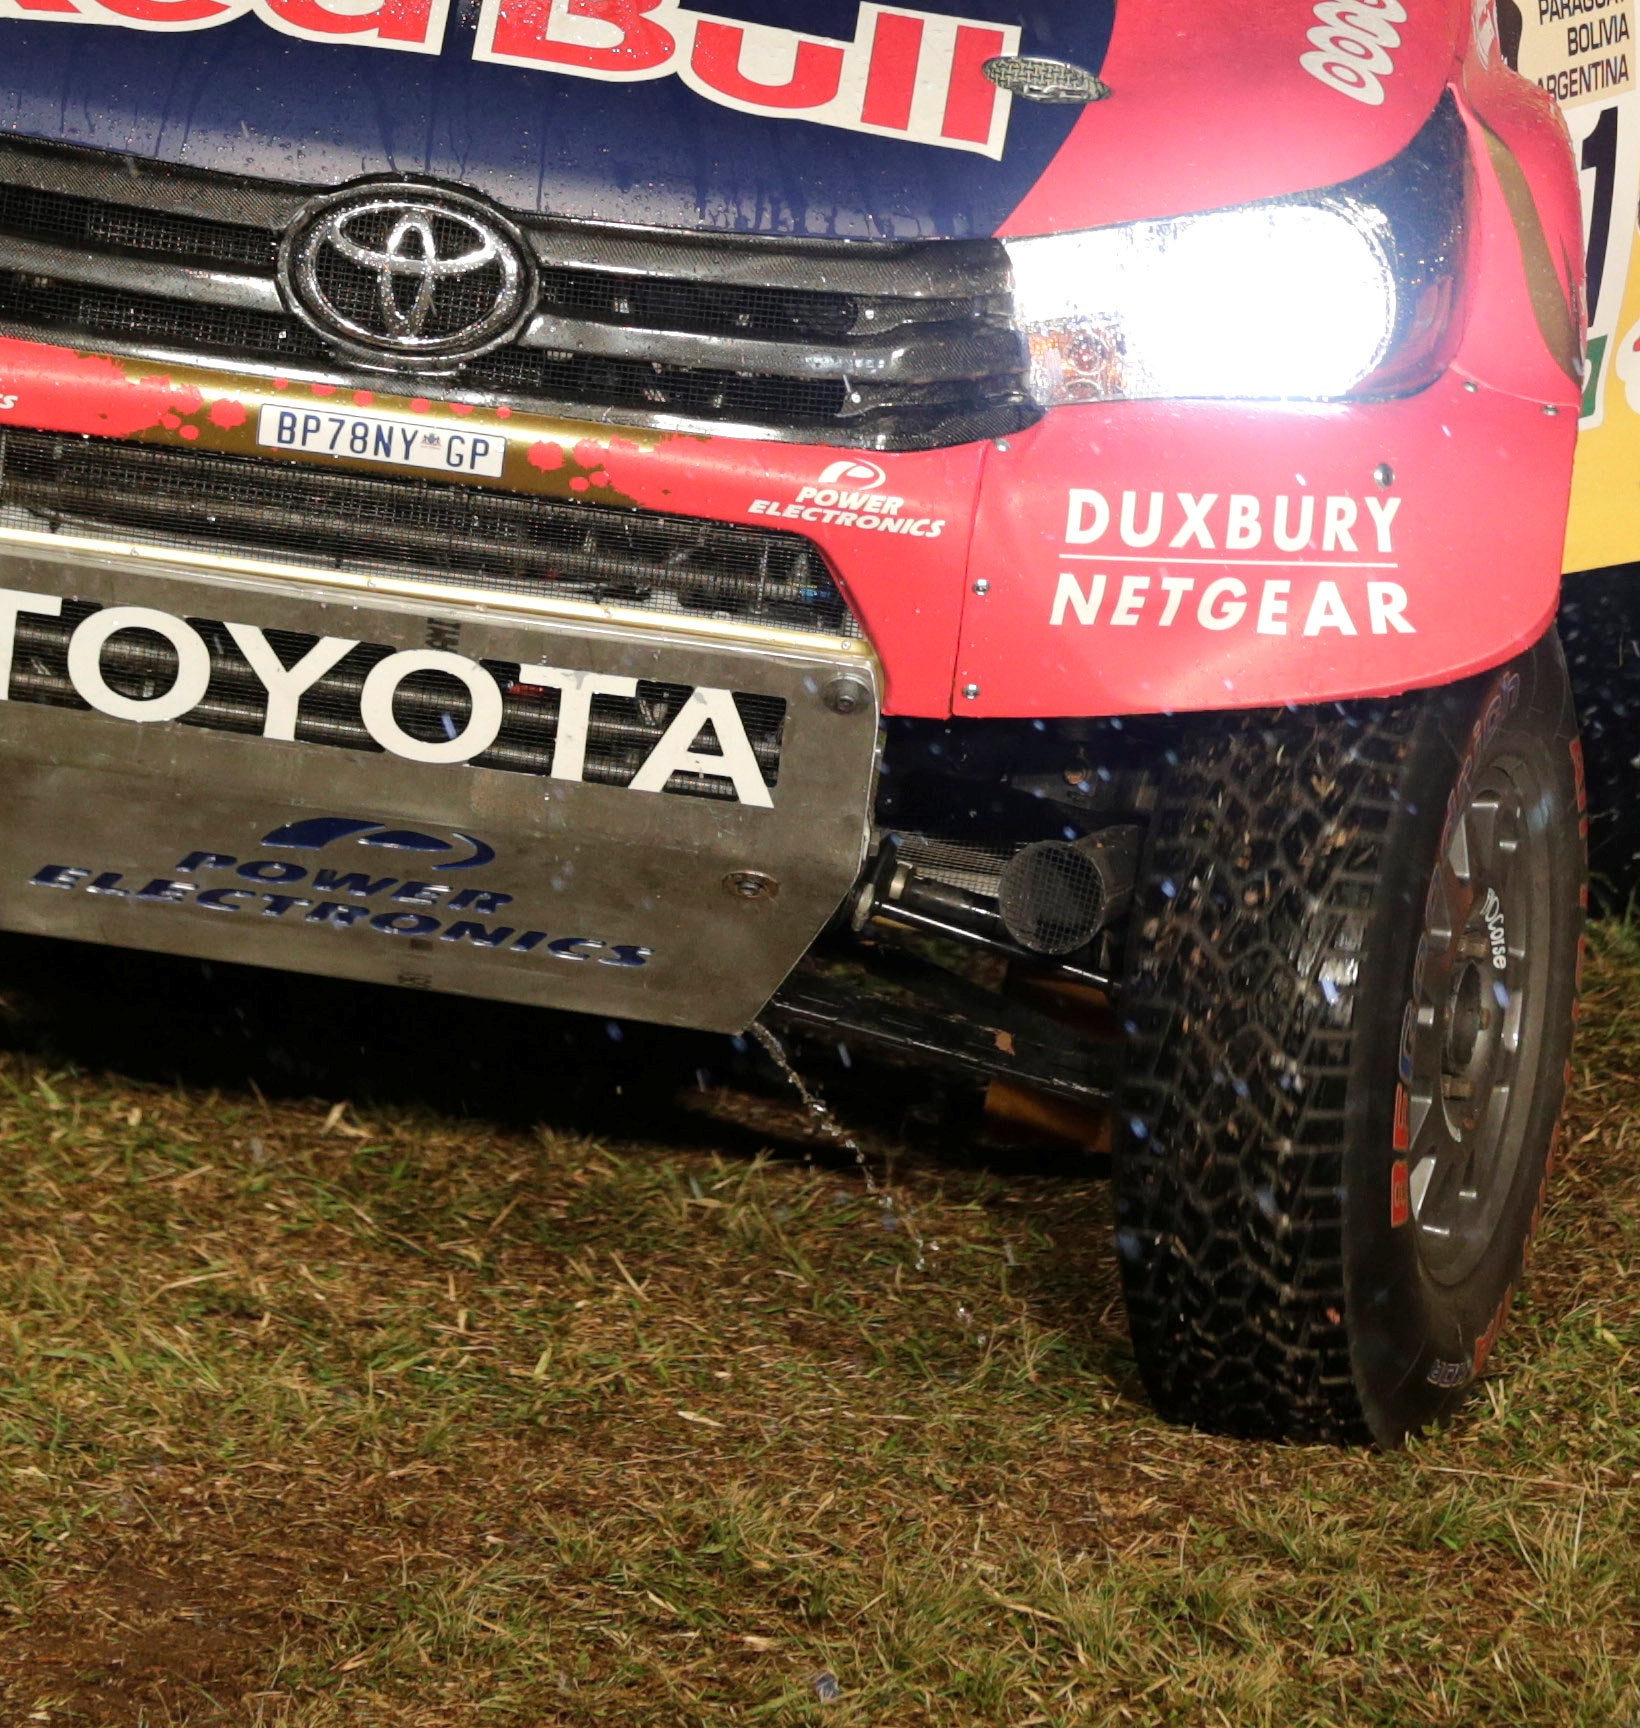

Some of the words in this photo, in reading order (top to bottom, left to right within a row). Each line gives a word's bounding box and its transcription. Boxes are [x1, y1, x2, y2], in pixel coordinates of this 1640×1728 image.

[1567, 12, 1630, 56] BOLIVIA
[277, 410, 419, 461] BP78NY
[446, 434, 490, 470] GP
[747, 498, 946, 539] ELECTRONICS
[794, 484, 905, 516] POWER
[1063, 488, 1402, 553] DUXBURY
[1048, 573, 1417, 637] NETGEAR
[172, 850, 514, 916] POWER
[28, 863, 658, 969] ELECTRONICS
